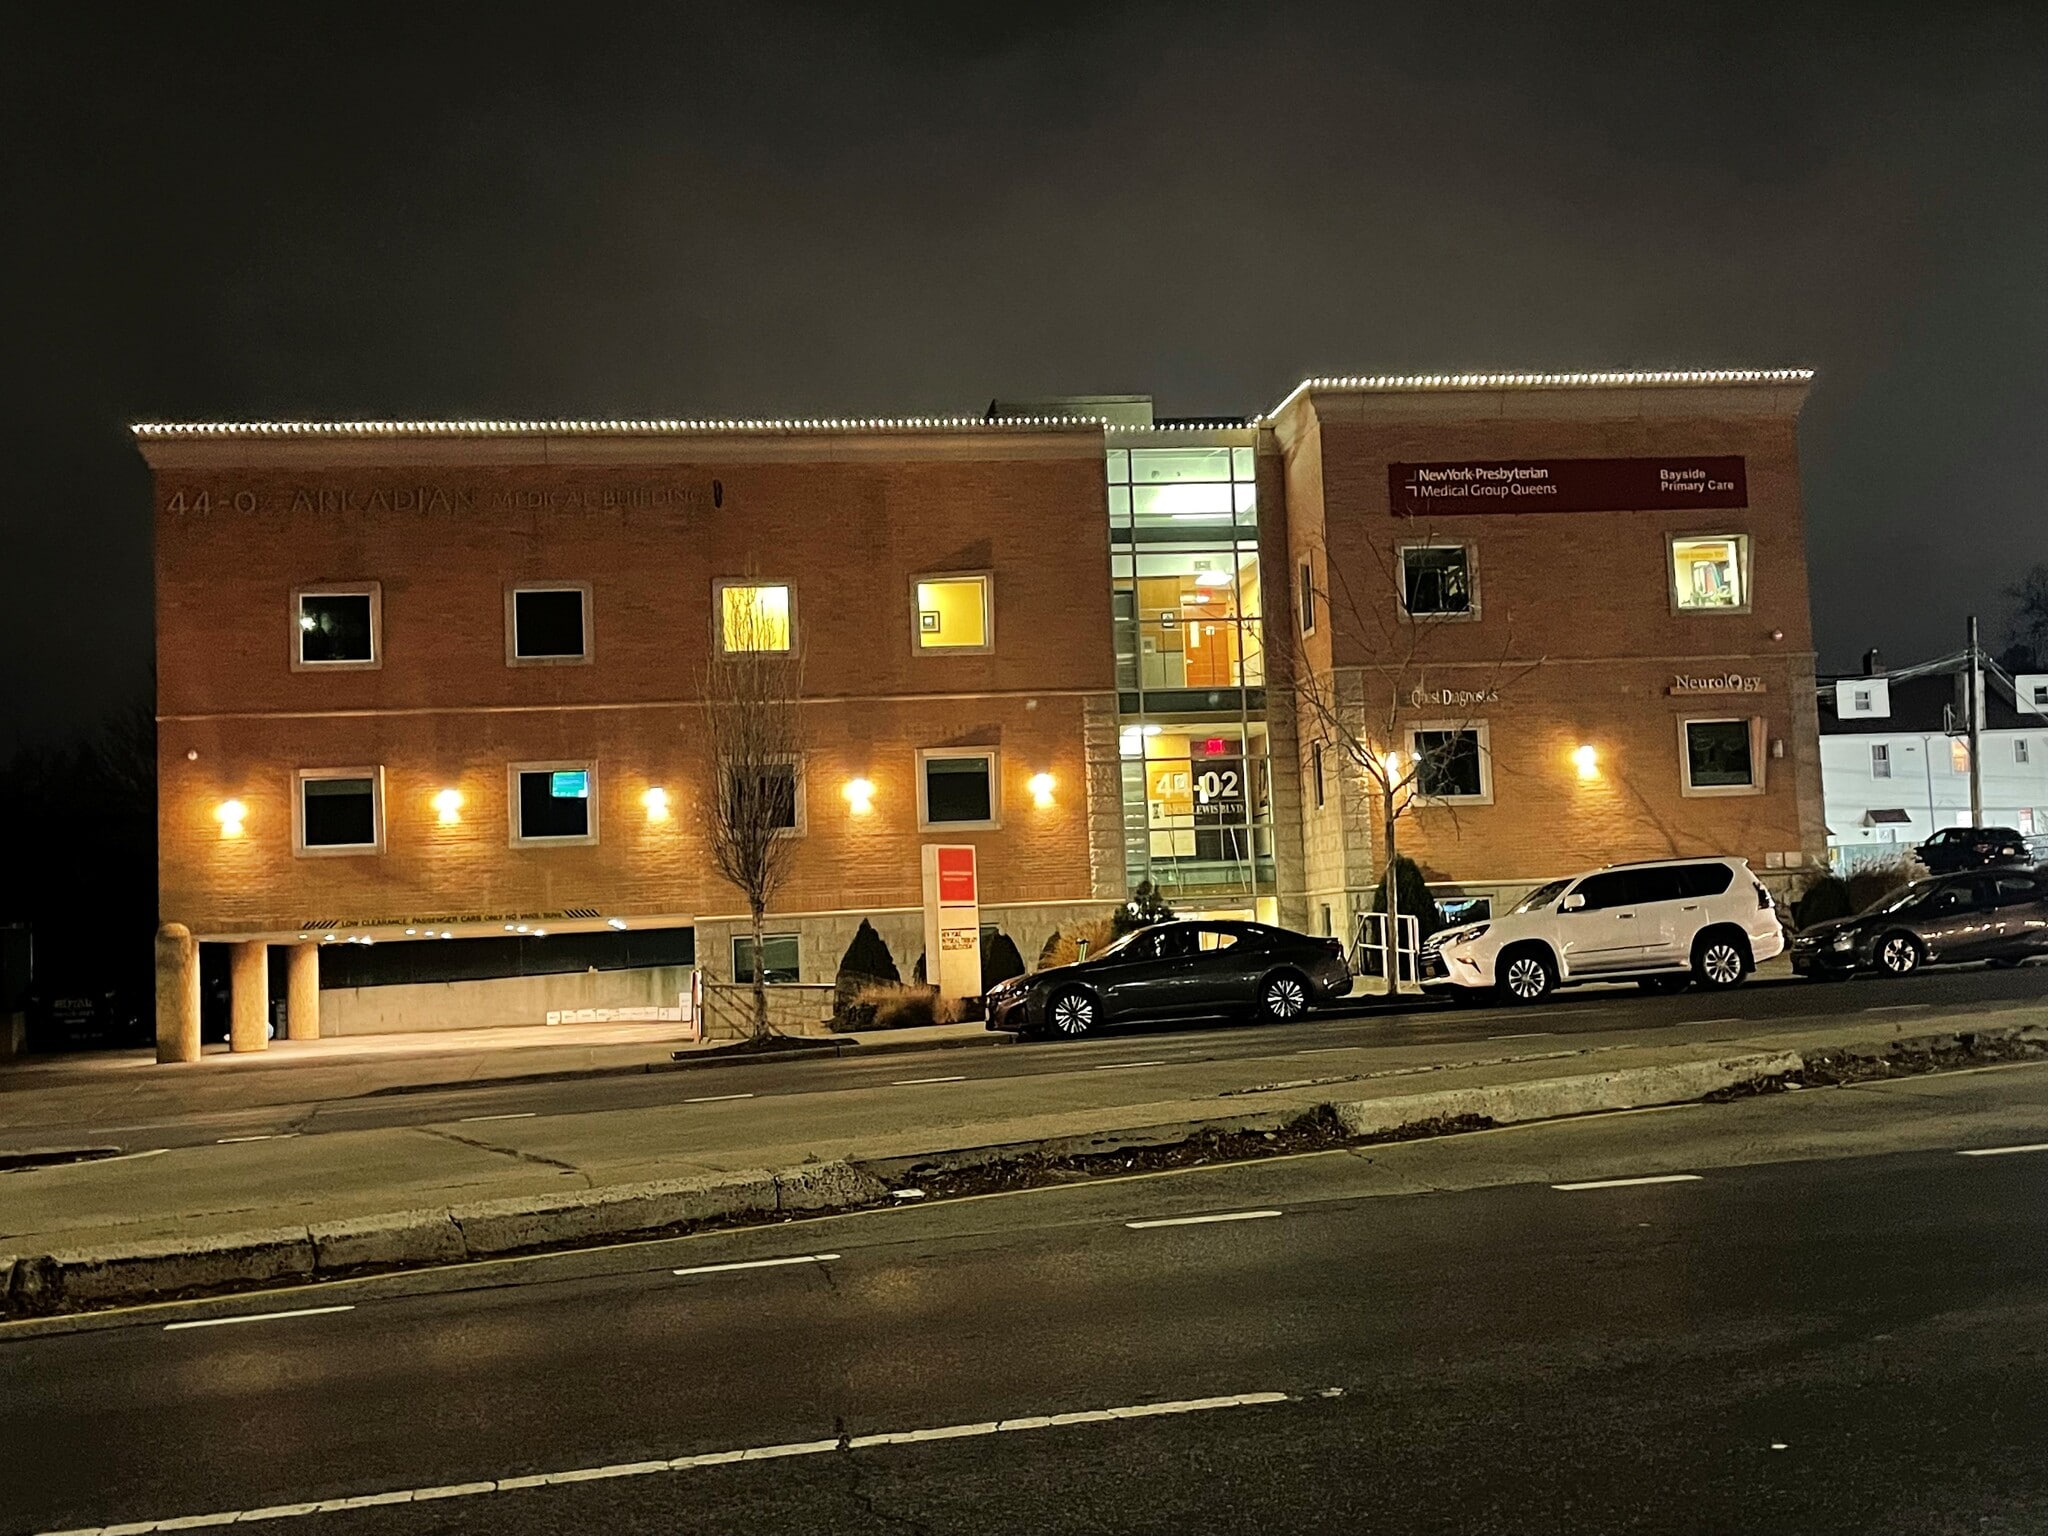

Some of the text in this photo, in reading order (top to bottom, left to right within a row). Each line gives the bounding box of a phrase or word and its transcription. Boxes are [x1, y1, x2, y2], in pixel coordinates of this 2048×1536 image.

[1660, 467, 1706, 482] Bayside
[1420, 483, 1558, 498] Medical Group Queens
[1661, 479, 1735, 493] Primary Care
